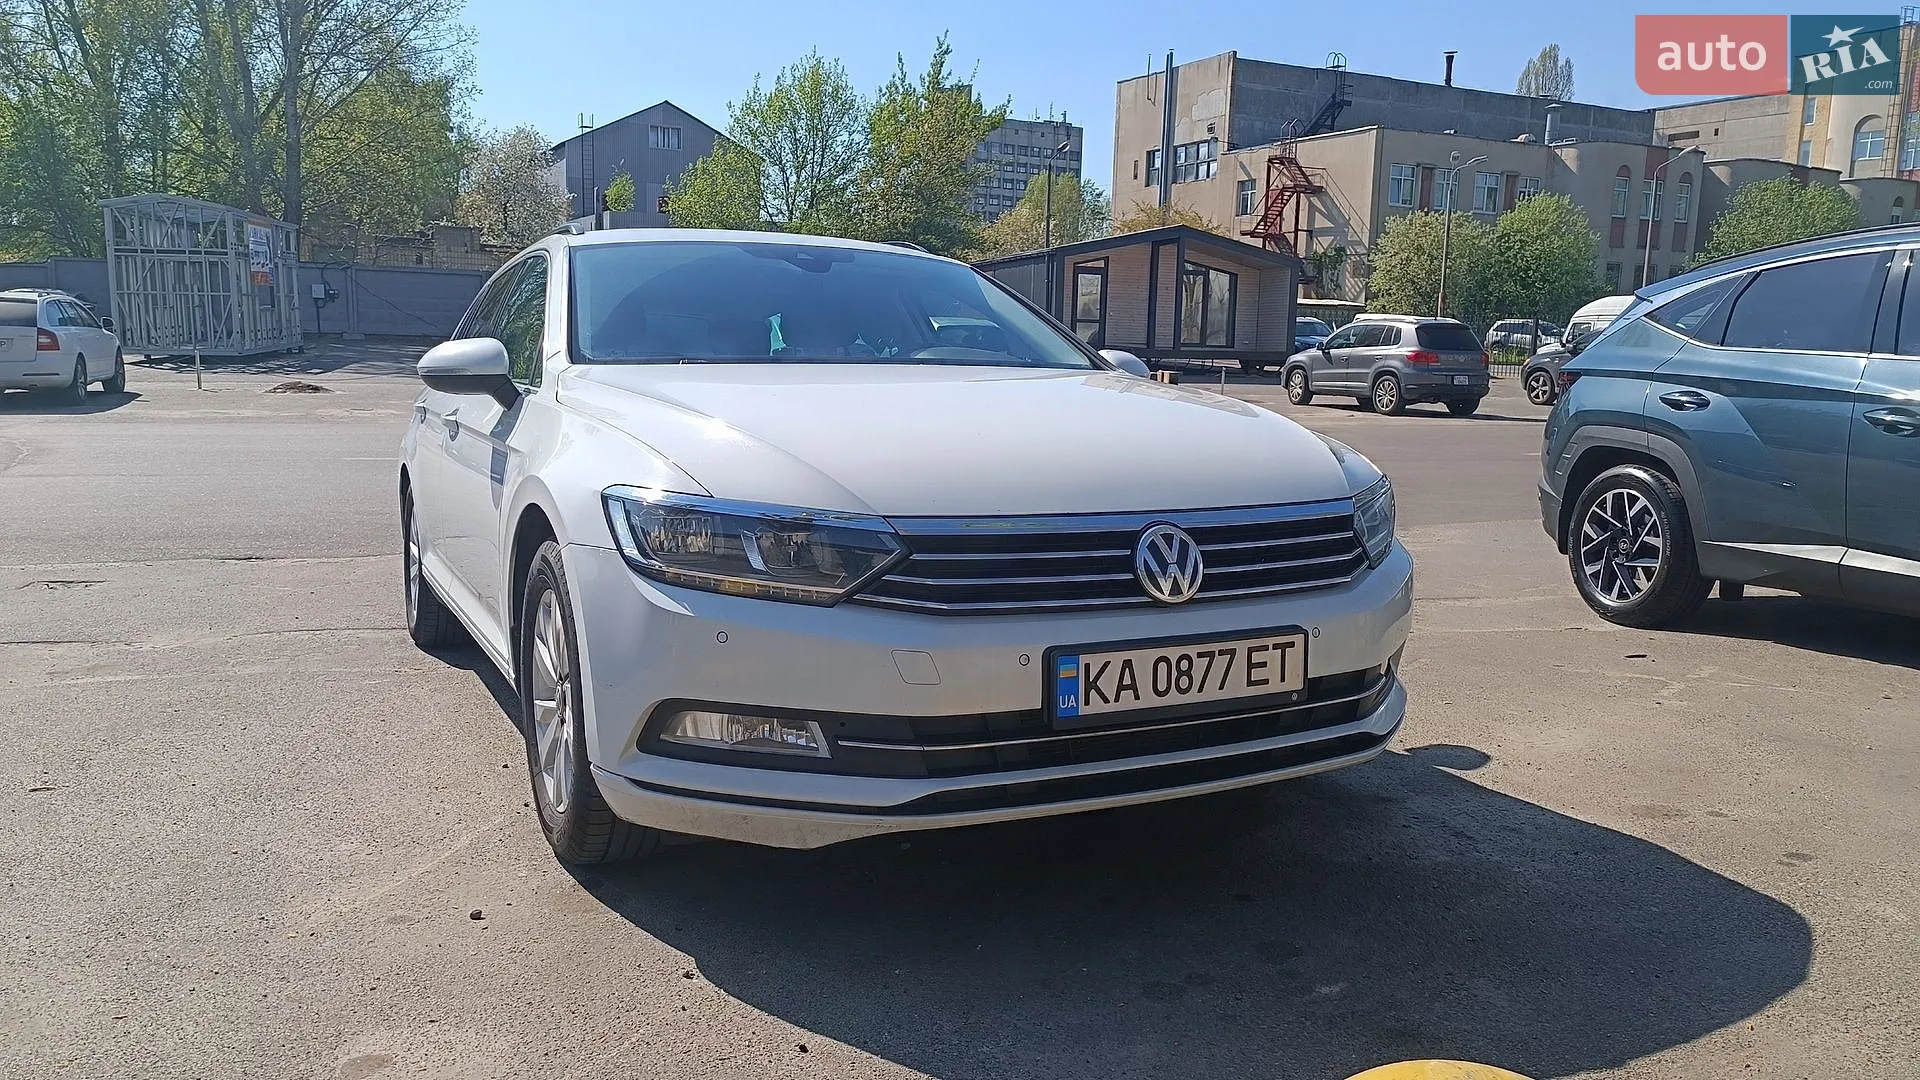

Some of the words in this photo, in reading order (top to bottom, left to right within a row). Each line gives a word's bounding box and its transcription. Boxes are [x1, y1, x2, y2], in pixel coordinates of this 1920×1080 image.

[1083, 658, 1141, 706] KA
[1152, 647, 1237, 698] 0877
[1246, 641, 1295, 687] ET
[1059, 694, 1077, 708] UA
